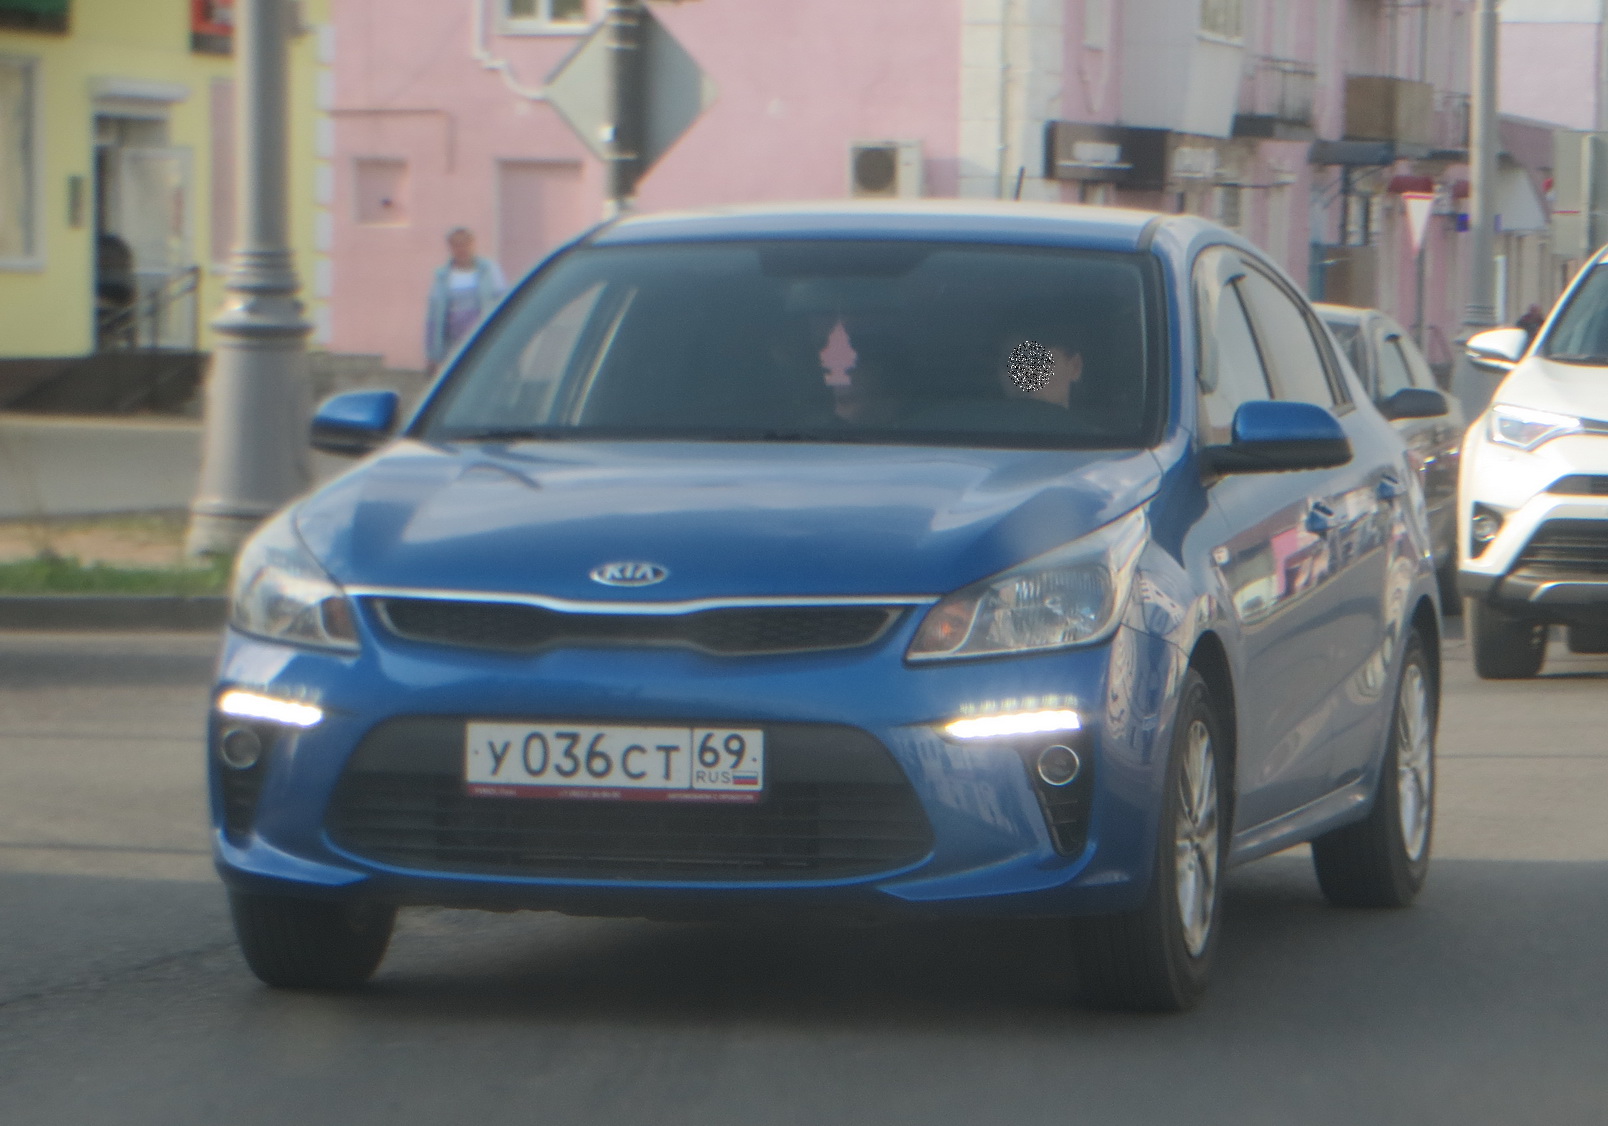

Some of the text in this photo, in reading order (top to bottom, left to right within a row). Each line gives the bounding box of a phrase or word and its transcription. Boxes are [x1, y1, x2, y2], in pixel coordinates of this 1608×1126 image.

[601, 562, 657, 582] KIA
[698, 732, 746, 769] 69
[695, 770, 731, 784] RUS
